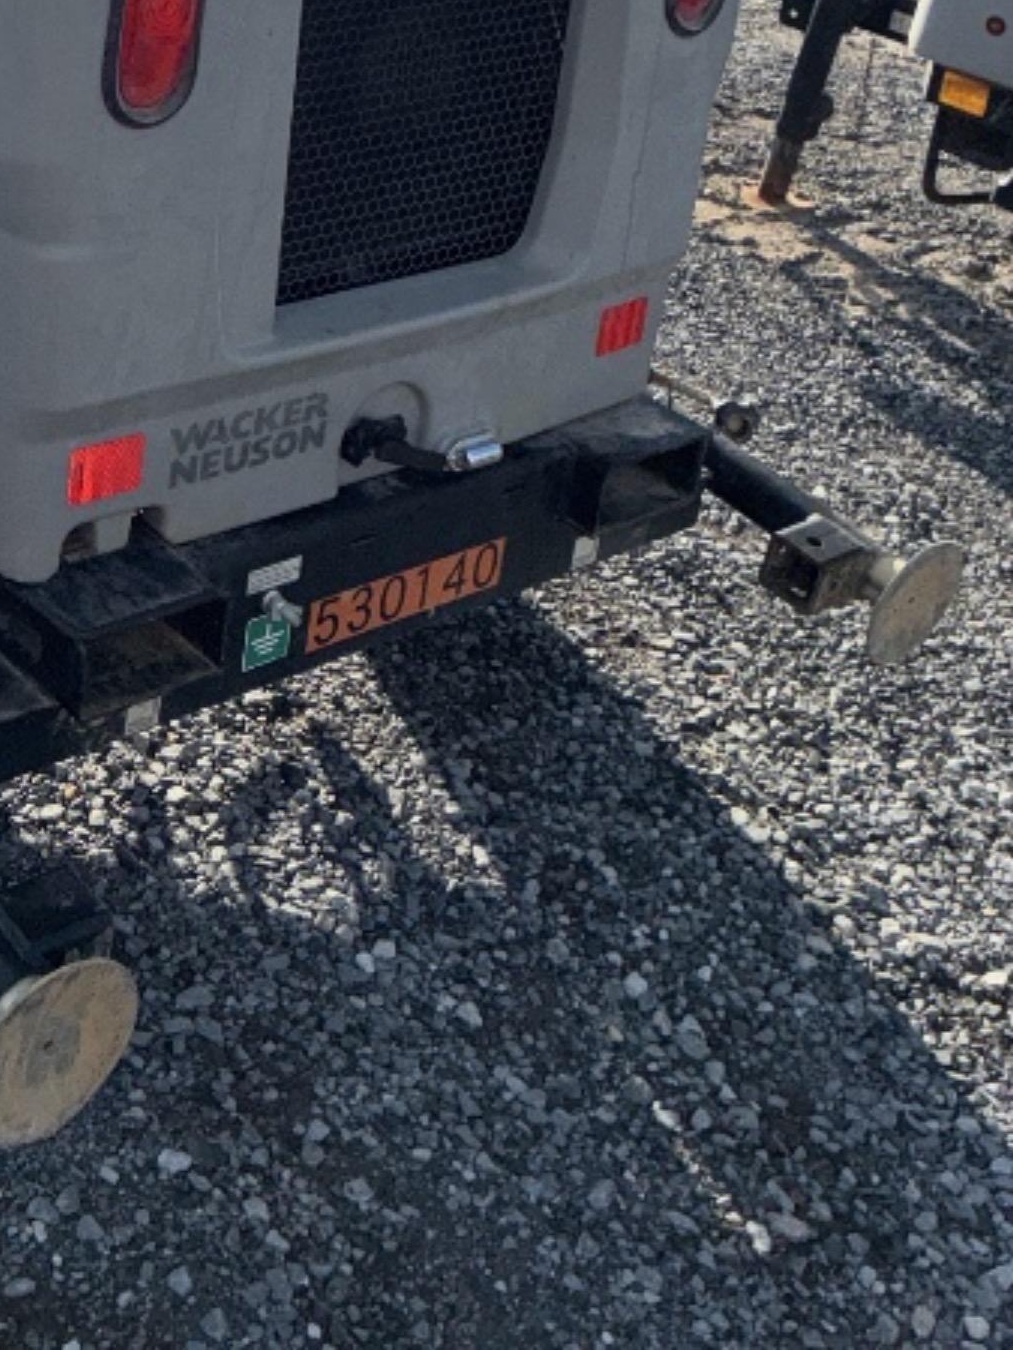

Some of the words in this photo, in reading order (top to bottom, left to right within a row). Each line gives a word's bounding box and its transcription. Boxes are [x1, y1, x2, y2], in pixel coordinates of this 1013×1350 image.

[166, 422, 328, 491] NEUSON
[169, 391, 330, 458] WACKER
[313, 541, 499, 647] 530140
